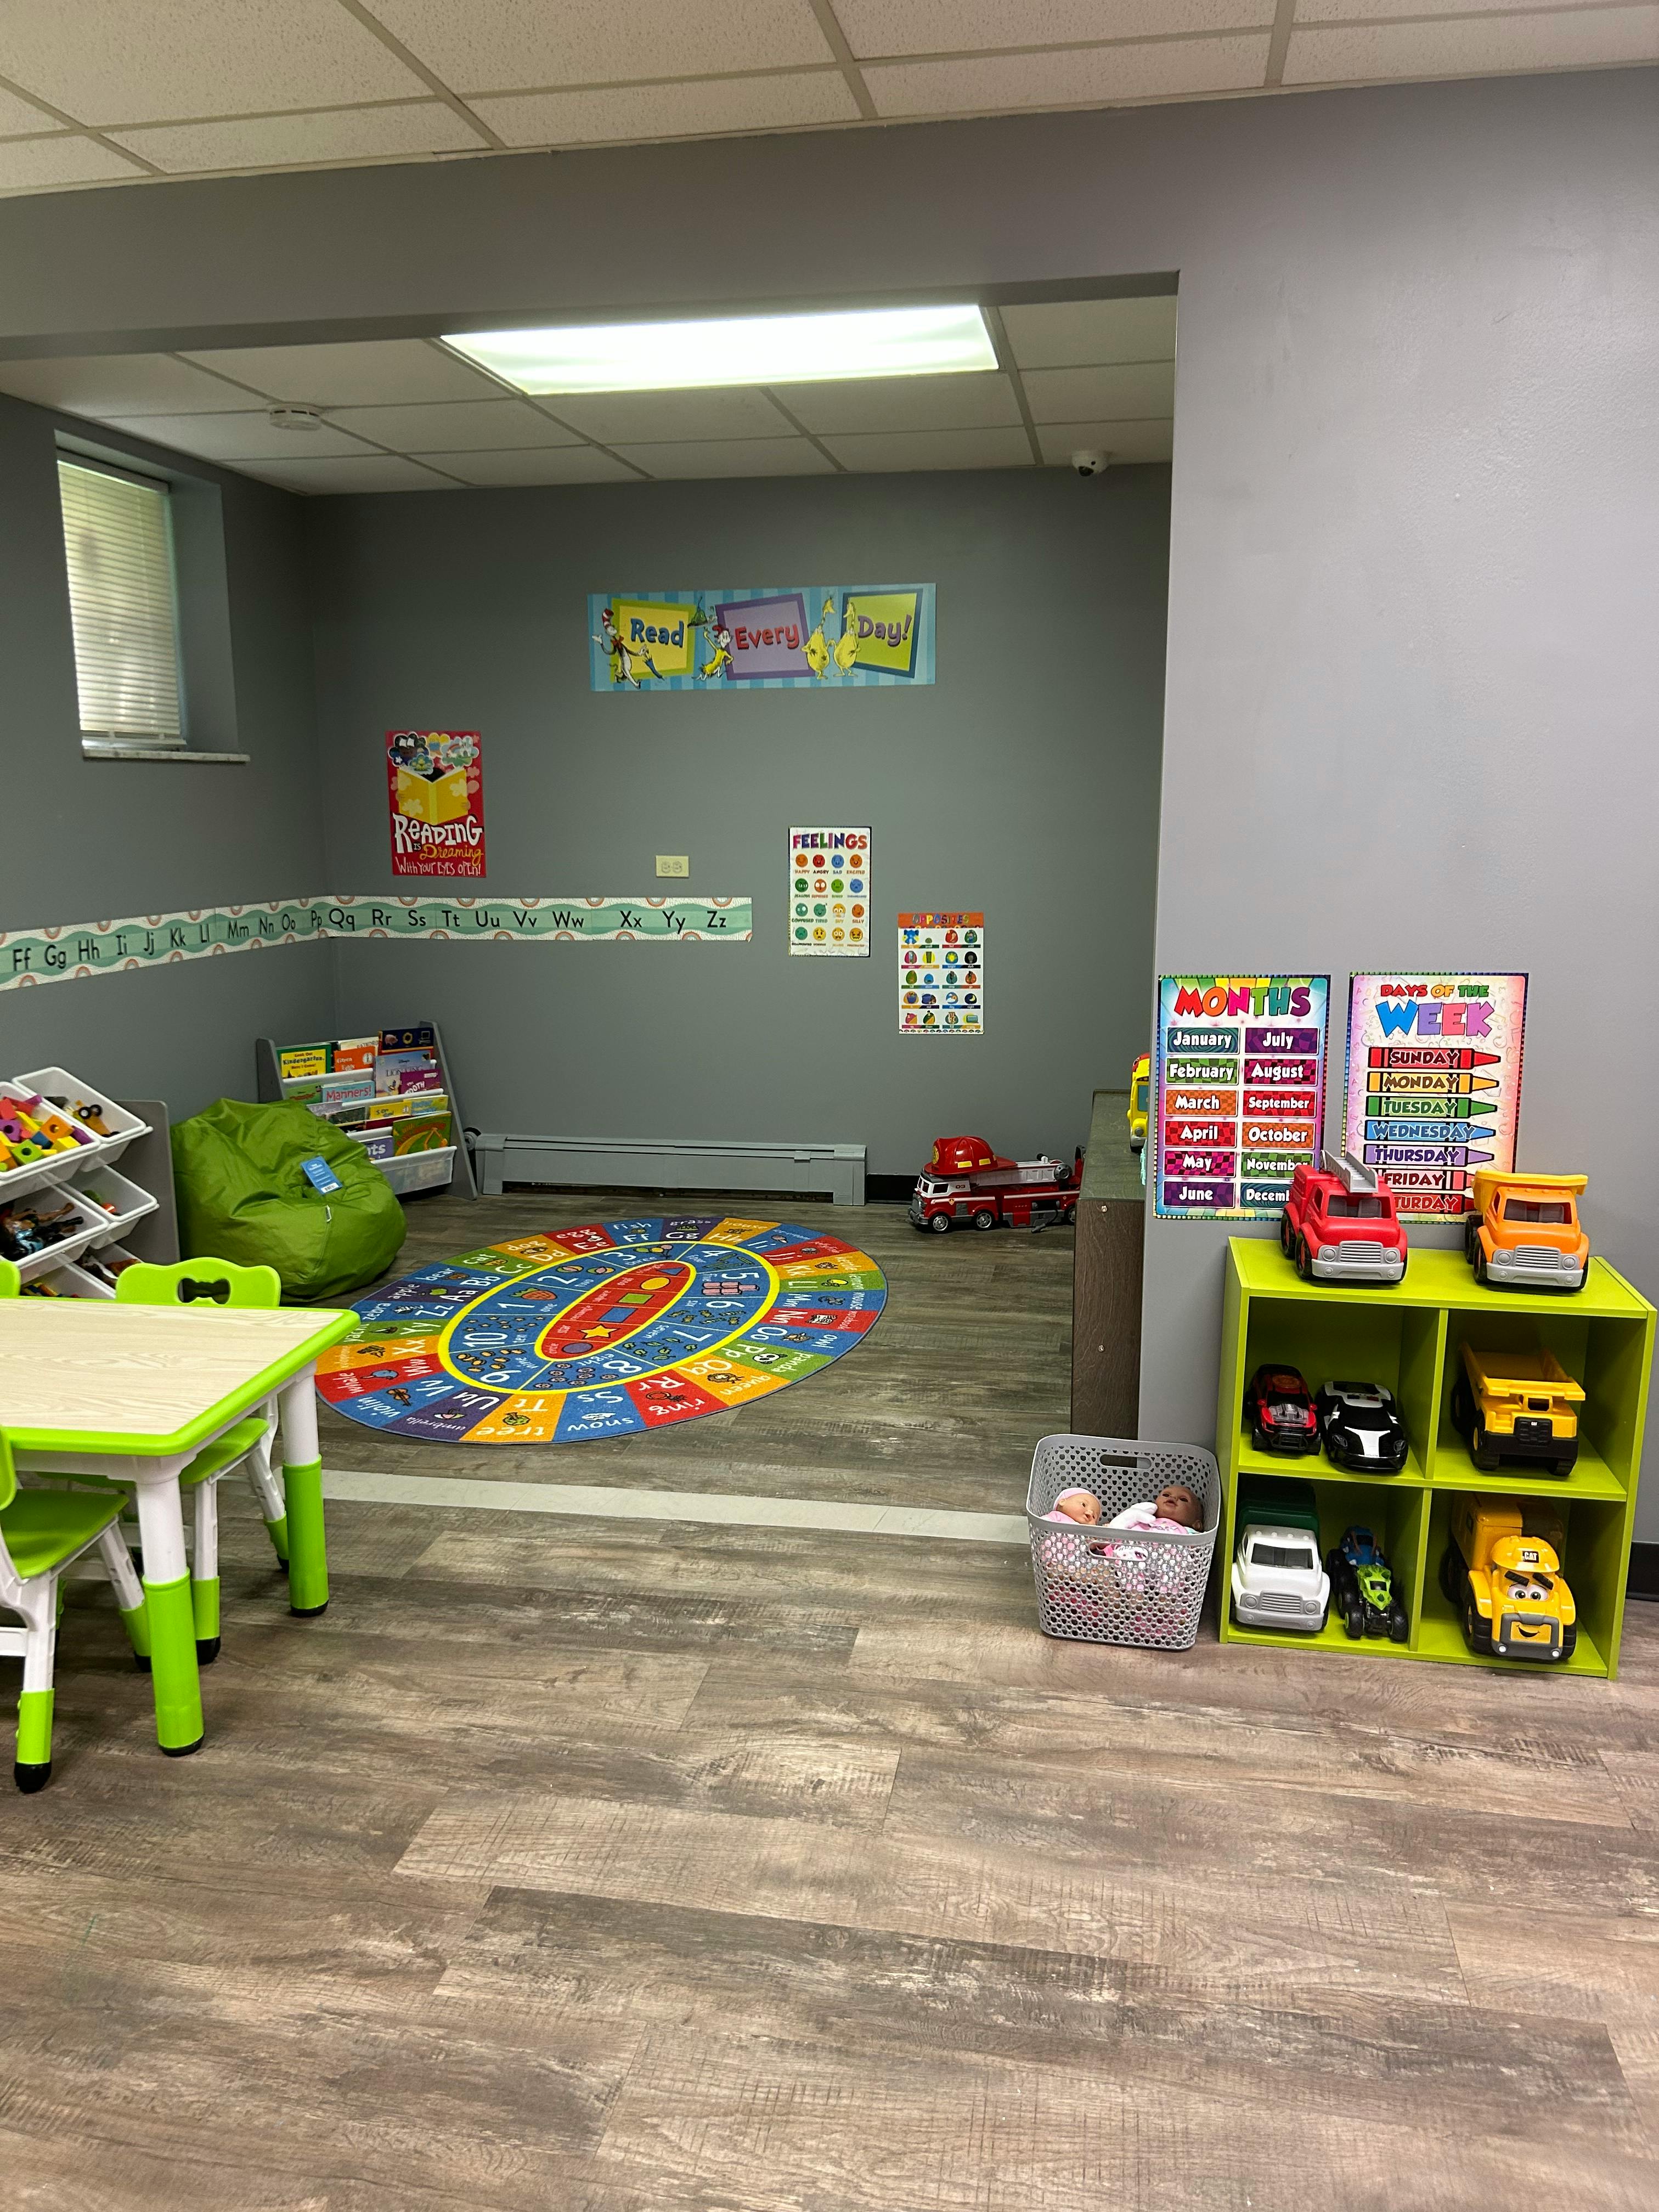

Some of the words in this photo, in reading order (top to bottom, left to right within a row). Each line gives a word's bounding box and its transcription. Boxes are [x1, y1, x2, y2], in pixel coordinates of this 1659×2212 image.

[630, 618, 684, 648] Read
[735, 623, 800, 651] Every
[857, 614, 912, 647] Day!
[793, 833, 868, 850] FEELINGS
[420, 844, 484, 867] Dreaming
[912, 913, 970, 924] OPPOSITES
[13, 947, 31, 971] Ff
[44, 945, 66, 969] Gg
[78, 939, 100, 961] Hh
[144, 931, 155, 956] Jj
[170, 927, 186, 947] Kk
[228, 921, 249, 939] Mm
[259, 916, 274, 935] Nn
[282, 913, 296, 931] Oo
[311, 910, 322, 931] Pp
[329, 908, 355, 931] Qq
[372, 909, 392, 926] Rr
[408, 910, 426, 927] Ss
[442, 910, 460, 927] Tt
[476, 911, 500, 928] Uu
[513, 911, 537, 928] Vv
[552, 911, 584, 928] Ww
[620, 911, 642, 928] Xx
[663, 911, 685, 934] Yy
[707, 911, 726, 928] Zz
[1380, 984, 1427, 997] DAYS
[1431, 984, 1454, 997] OF
[1458, 985, 1489, 997] THE
[1174, 986, 1311, 1018] MONTHS
[1375, 999, 1494, 1037] WEEK
[1173, 1031, 1232, 1049] January
[1262, 1032, 1294, 1050] July
[1390, 1050, 1459, 1065] SUNDAY
[1170, 1063, 1234, 1081] February
[1251, 1063, 1304, 1081] August
[1384, 1076, 1459, 1090] MONDAY
[326, 1085, 371, 1101] Manners!
[1175, 1095, 1220, 1110] March
[1248, 1097, 1310, 1111] September
[1383, 1099, 1457, 1115] TUESDAY
[1180, 1124, 1218, 1142] April
[1248, 1127, 1308, 1143] October
[1373, 1124, 1475, 1141] WEDNESDAY
[1183, 1154, 1212, 1171] May
[1375, 1148, 1460, 1164] THURSDAY
[1384, 1172, 1444, 1186] FRIDAY
[1179, 1186, 1214, 1201] June
[557, 1229, 597, 1239] egg
[709, 1233, 742, 1243] Hh
[507, 1240, 546, 1251] dog
[573, 1242, 610, 1250] Ee
[463, 1254, 496, 1265] cat
[528, 1250, 569, 1262] Dd
[603, 1251, 637, 1261] 3
[415, 1267, 455, 1281] bear
[495, 1263, 533, 1274] Cc
[782, 1265, 817, 1277] Kk
[459, 1276, 501, 1287] Bb
[537, 1276, 579, 1284] 2
[387, 1284, 420, 1300] apple
[439, 1290, 479, 1302] Aa
[783, 1293, 812, 1307] Mm
[361, 1302, 391, 1321] zebra
[414, 1305, 455, 1317] Zz
[769, 1310, 808, 1324] Nn
[400, 1323, 442, 1335] Yy
[673, 1330, 713, 1342] 7
[750, 1327, 788, 1340] Oo
[462, 1332, 508, 1347] 10
[811, 1334, 838, 1348] owl
[392, 1339, 427, 1355] Xx
[721, 1344, 767, 1358] Pp
[402, 1358, 433, 1376] Ww
[602, 1359, 642, 1374] 8
[677, 1359, 733, 1376] Qq
[771, 1352, 815, 1373] panda
[332, 1372, 365, 1394] whale
[479, 1370, 522, 1383] 9
[638, 1376, 686, 1391] Rr
[415, 1380, 454, 1397] Vv
[719, 1374, 772, 1396] queen
[452, 1391, 500, 1410] Uu
[577, 1391, 624, 1403] Ss
[357, 1397, 402, 1418] violin
[514, 1398, 549, 1412] Tt
[648, 1398, 706, 1415] ring
[406, 1417, 466, 1431] umbrella
[476, 1426, 545, 1436] tree
[567, 1417, 635, 1431] snow
[1525, 1551, 1538, 1561] CAT
